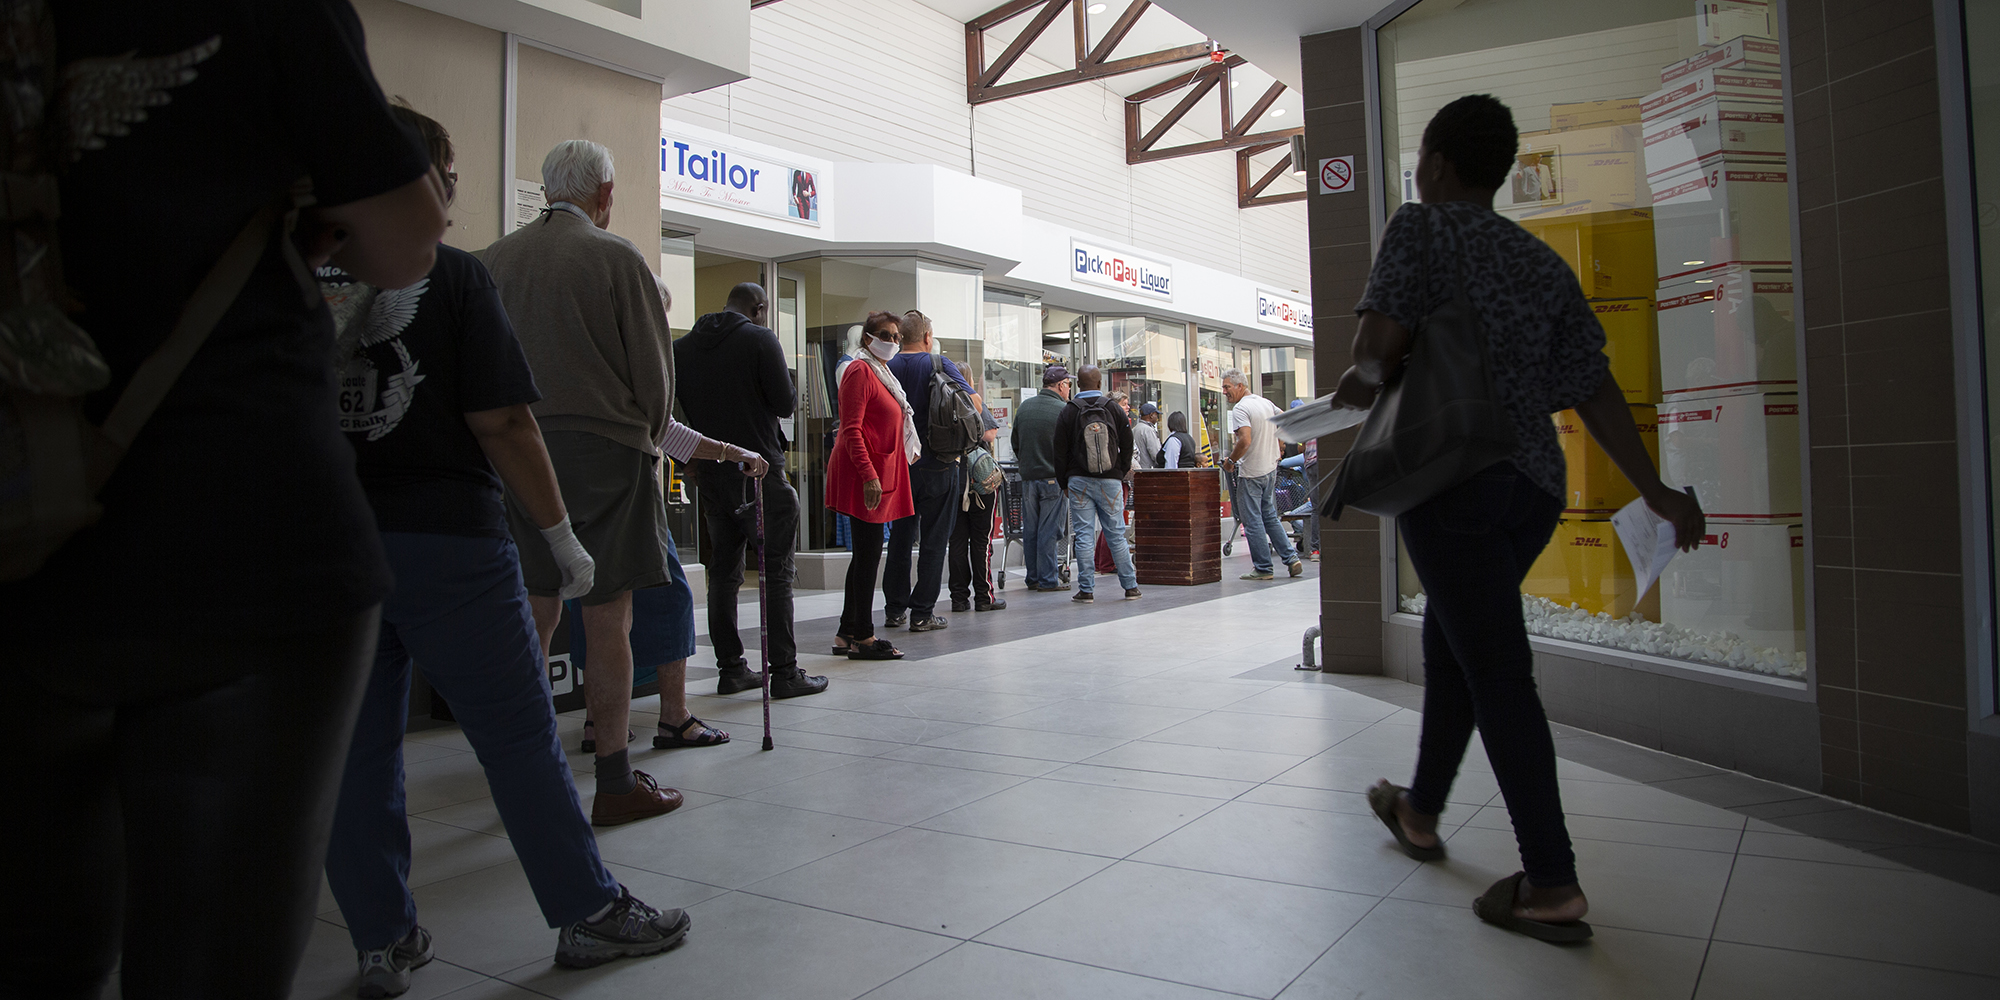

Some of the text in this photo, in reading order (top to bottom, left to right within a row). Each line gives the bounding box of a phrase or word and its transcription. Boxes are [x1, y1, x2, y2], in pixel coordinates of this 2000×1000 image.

[1725, 46, 1732, 58] 2
[1698, 79, 1704, 91] 3
[1701, 113, 1708, 126] 4
[1525, 143, 1532, 153] 3
[673, 140, 760, 193] Tailor
[1593, 158, 1622, 166] DHL
[1710, 170, 1719, 189] 5
[667, 178, 751, 206] Made To Measure
[1594, 259, 1601, 272] 5
[1140, 266, 1170, 291] Liquor
[1716, 284, 1724, 301] 6
[1594, 303, 1632, 313] DHL
[1298, 309, 1313, 327] Liqu
[341, 374, 367, 388] oute
[338, 390, 365, 413] 62
[352, 414, 388, 429] Rally
[1715, 405, 1723, 423] 7
[1574, 491, 1581, 507] 7
[1574, 536, 1603, 548] DHL
[1720, 532, 1729, 549] 8
[619, 915, 646, 939] N
